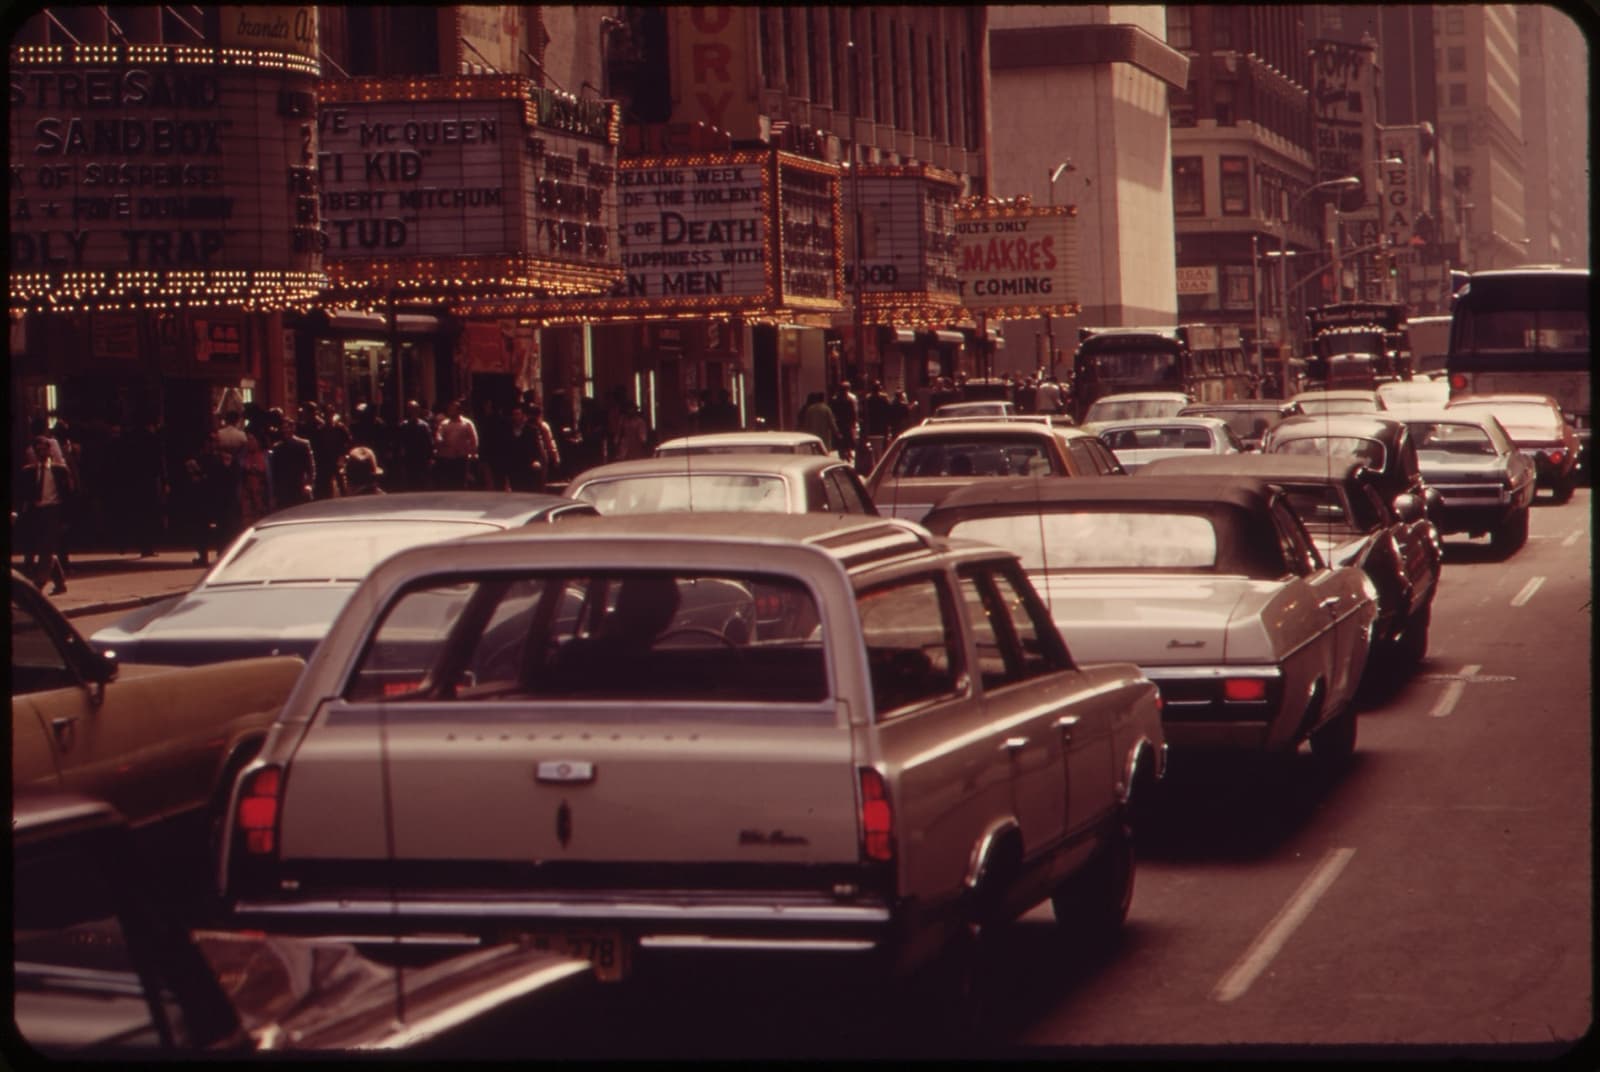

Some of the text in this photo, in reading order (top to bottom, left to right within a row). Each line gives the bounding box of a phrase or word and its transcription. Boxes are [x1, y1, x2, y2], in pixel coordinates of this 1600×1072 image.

[694, 168, 744, 183] WEEK
[624, 187, 762, 206] OF THE VIOLENT
[634, 222, 656, 236] OF
[996, 221, 1029, 232] ONLY
[721, 248, 764, 263] WITH
[975, 278, 1052, 296] COMING
